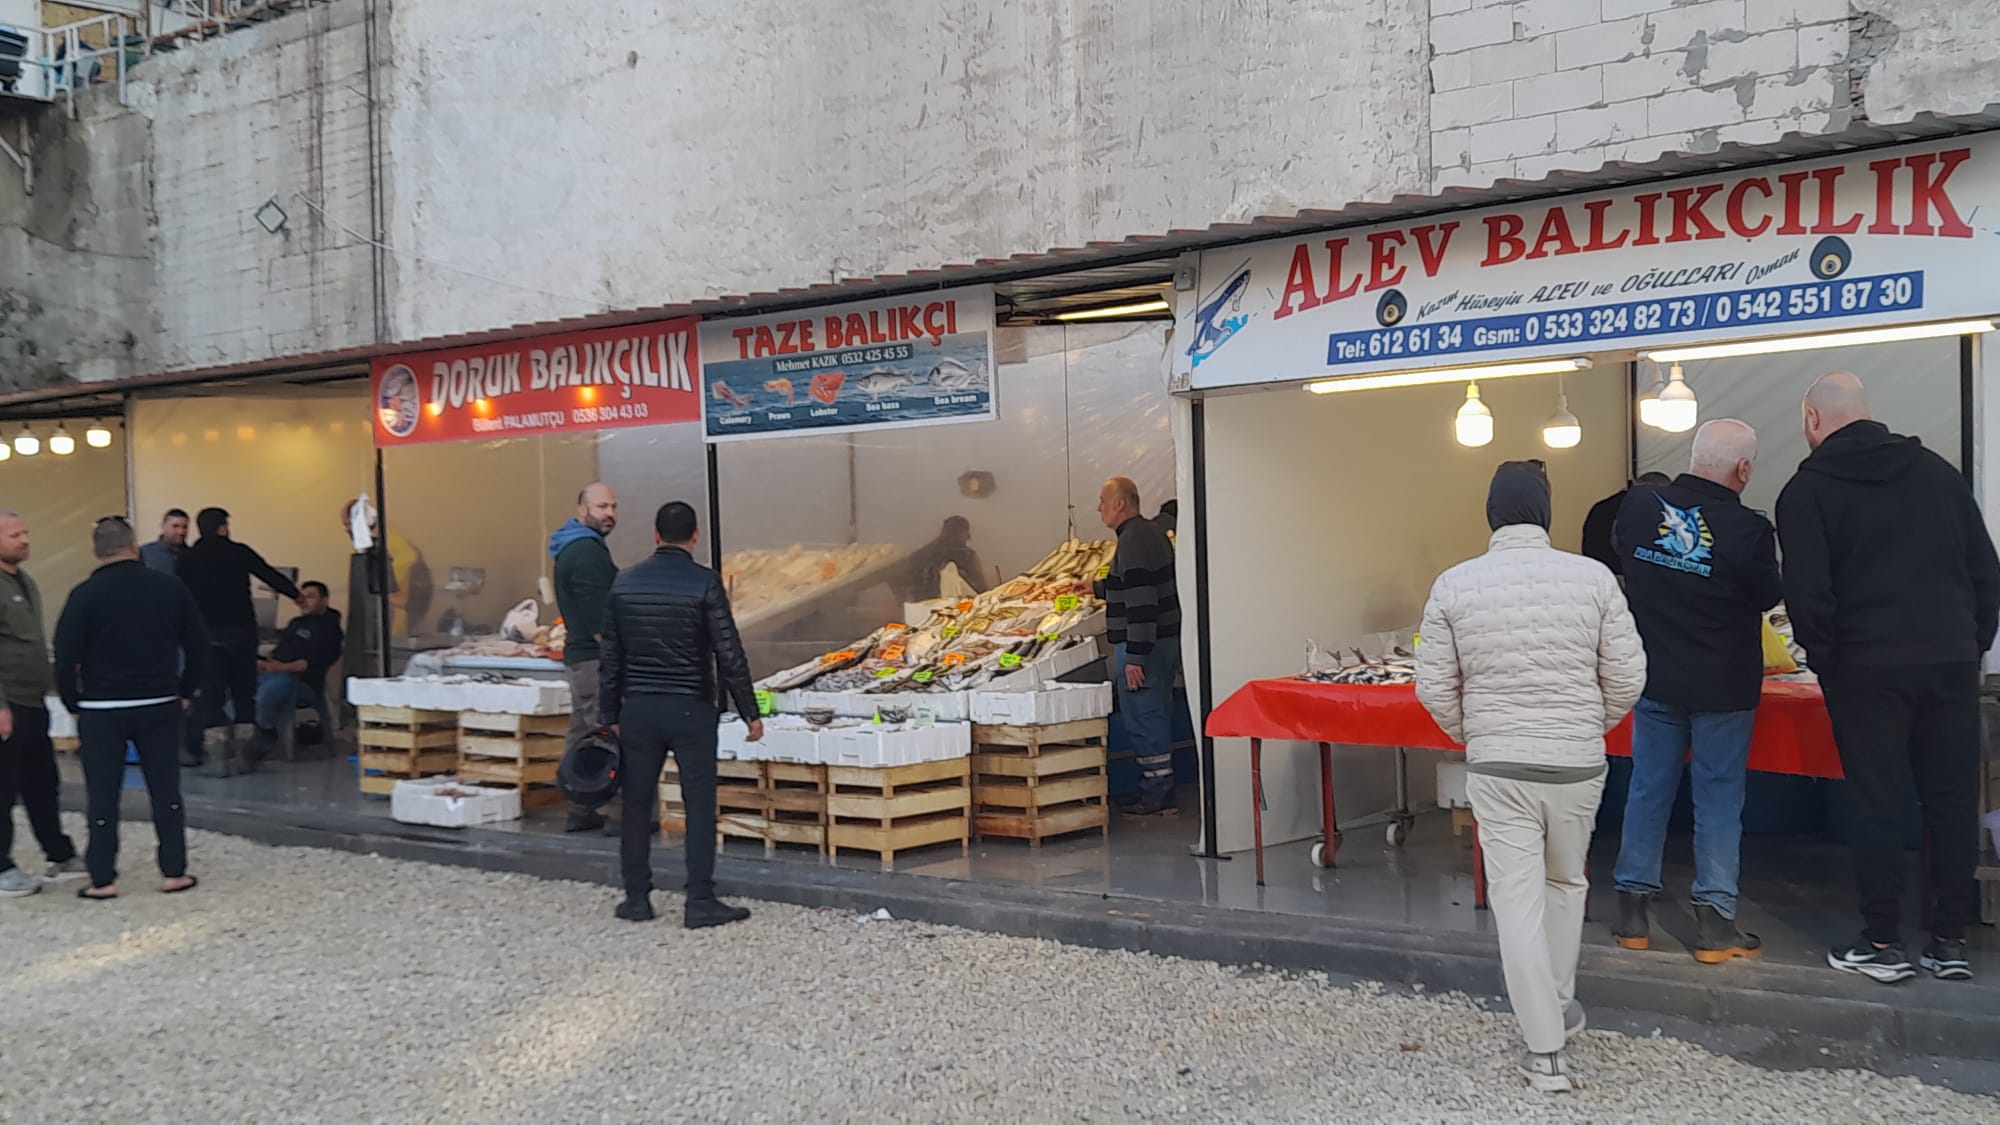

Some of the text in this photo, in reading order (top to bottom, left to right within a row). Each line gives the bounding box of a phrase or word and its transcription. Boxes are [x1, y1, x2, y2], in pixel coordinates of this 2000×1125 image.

[1273, 221, 1460, 320] ALEV
[1454, 291, 1524, 312] Hüseyin
[1528, 281, 1590, 304] ALEV
[1591, 283, 1614, 297] ve
[1620, 261, 1745, 293] OĞULLARI
[1745, 248, 1800, 285] Osman
[732, 300, 957, 359] TAZE BALIKÇI
[1336, 341, 1366, 360] Tel:
[1369, 331, 1403, 356] 612
[1408, 328, 1432, 353] 61
[1438, 325, 1462, 349] 34
[1473, 327, 1520, 346] Gsm:
[1525, 316, 1539, 341] 0
[1544, 312, 1583, 339] 533
[1589, 307, 1628, 335] 324
[1634, 303, 1662, 330] 82
[1668, 299, 1696, 327] 73
[1716, 296, 1731, 322] 0
[1737, 290, 1781, 320] 542
[1788, 285, 1832, 315] 551
[1842, 281, 1873, 308] 87
[1879, 277, 1912, 305] 30
[431, 331, 692, 416] DORUK BALIKÇILIK
[776, 346, 909, 372] Mehmet KAZIK 0532 425 45 55
[573, 408, 598, 423] 0536
[599, 406, 618, 421] 304
[620, 405, 633, 419] 43
[634, 403, 648, 417] 03
[810, 408, 838, 417] Lobster
[865, 403, 880, 411] Sea
[934, 396, 949, 405] Sea
